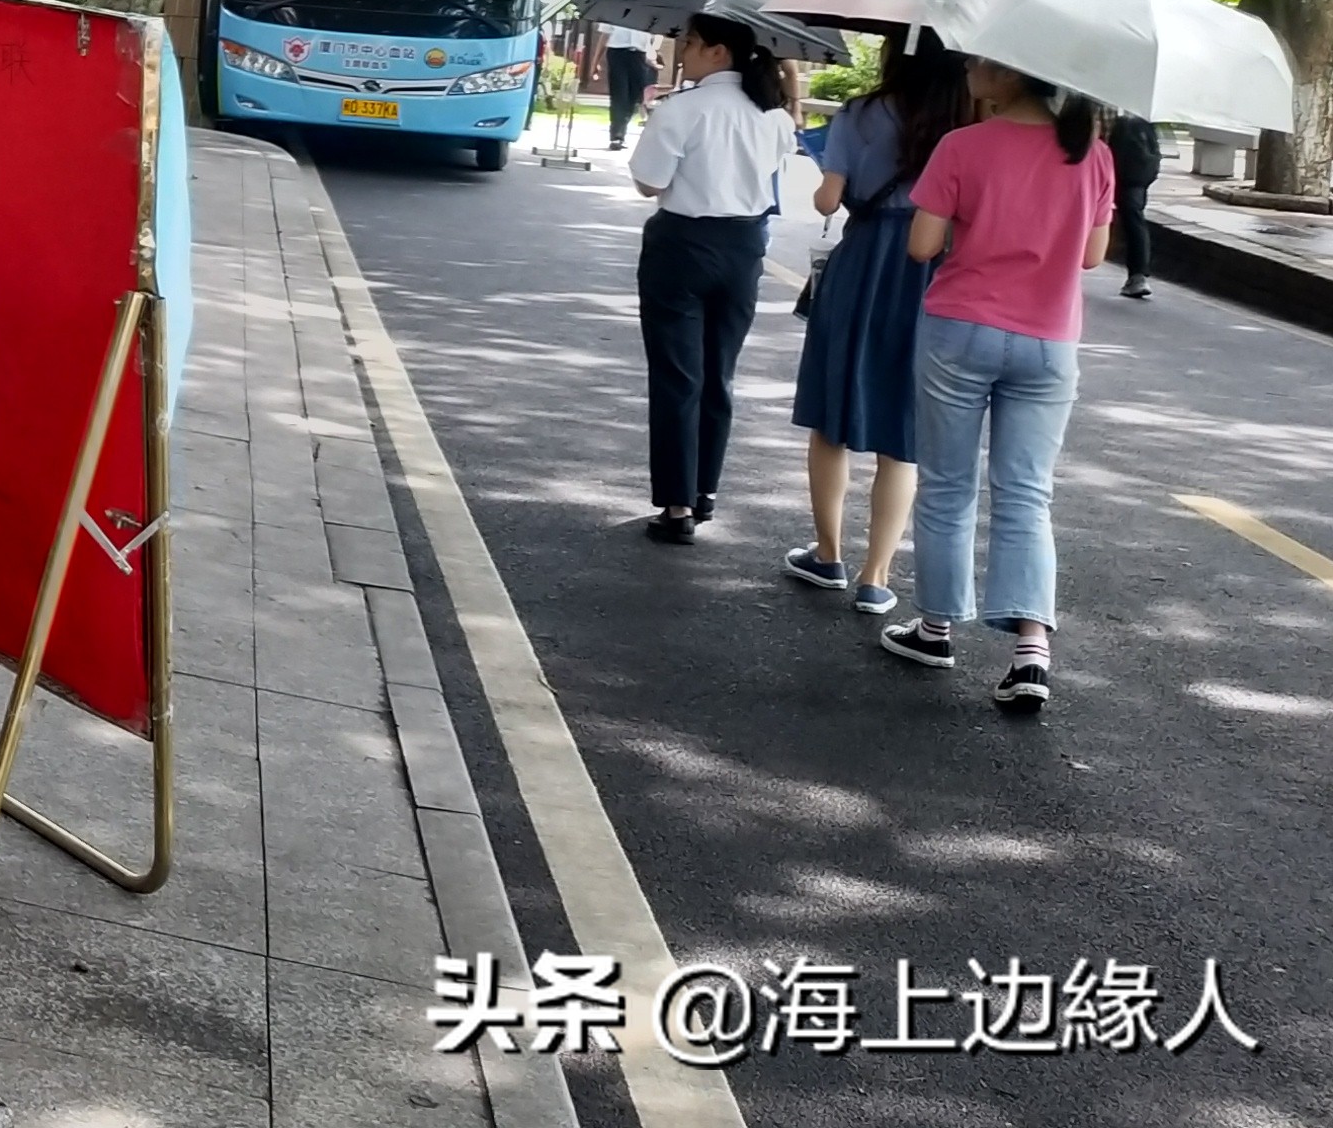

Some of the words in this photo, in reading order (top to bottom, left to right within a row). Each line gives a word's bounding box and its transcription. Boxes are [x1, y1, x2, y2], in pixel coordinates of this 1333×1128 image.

[319, 41, 415, 60] 厦门市中心血站
